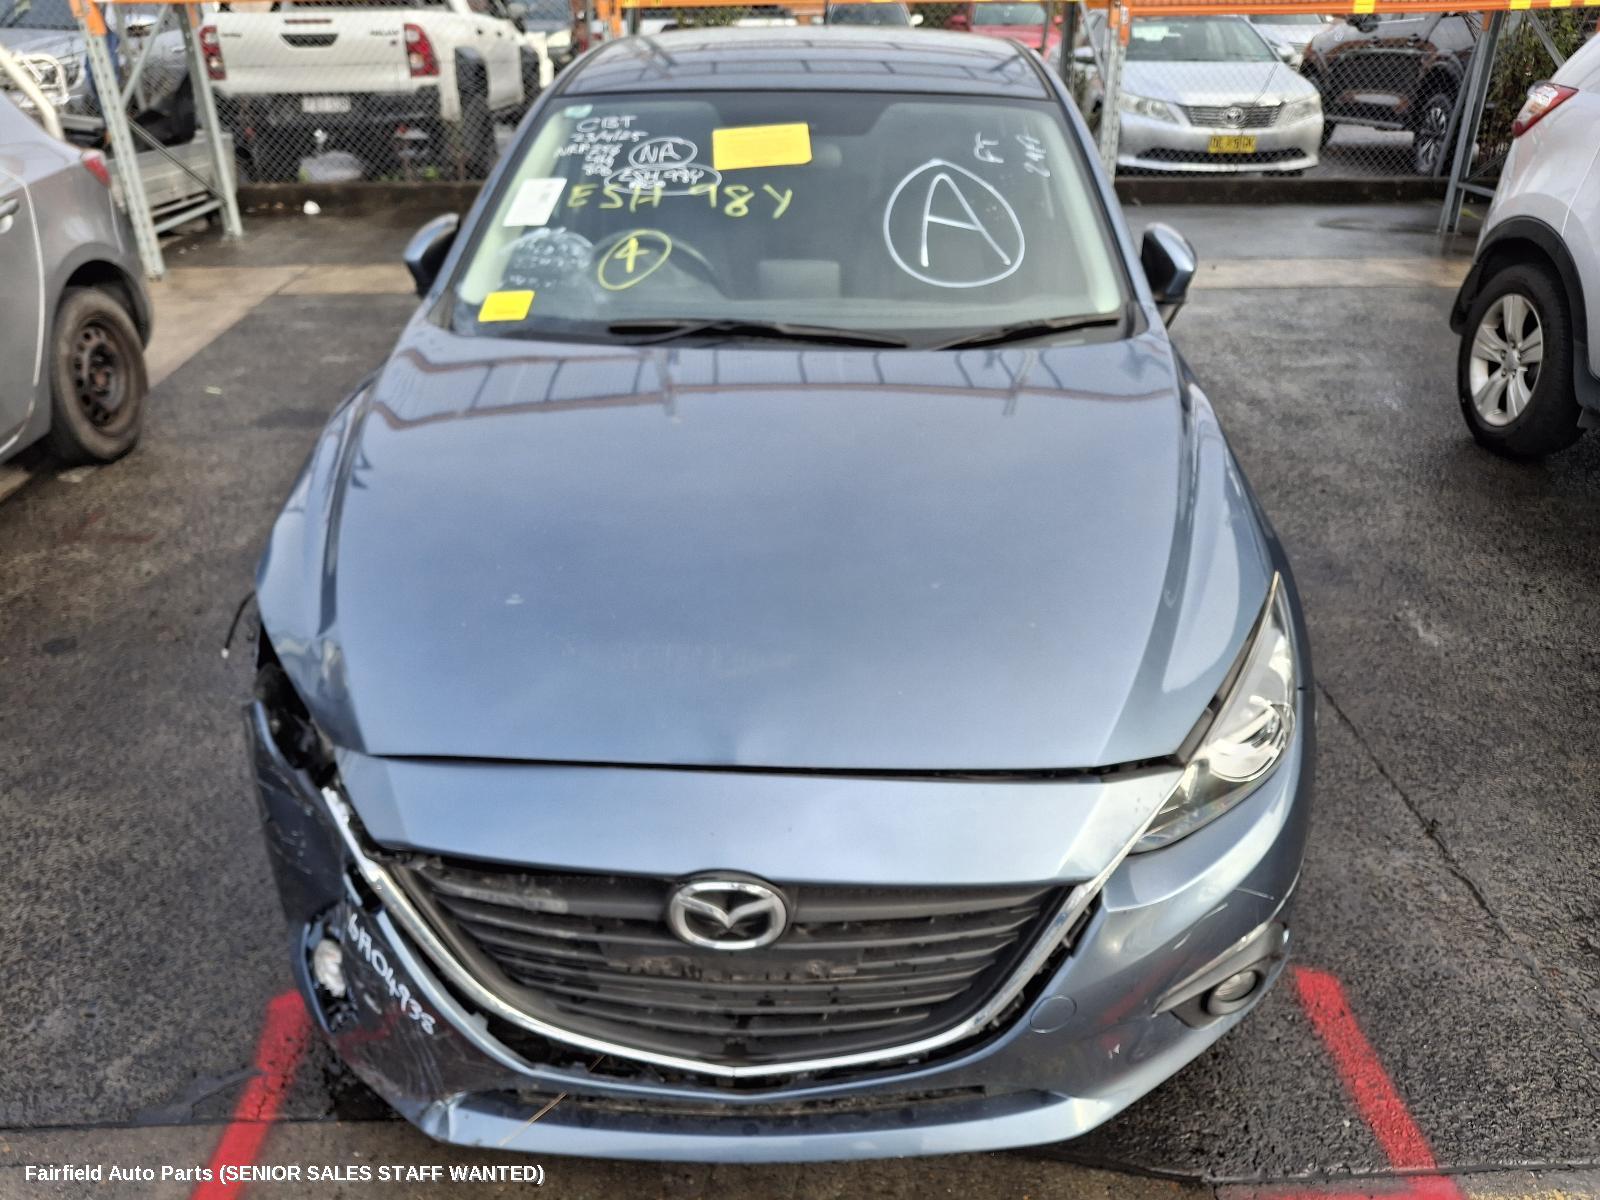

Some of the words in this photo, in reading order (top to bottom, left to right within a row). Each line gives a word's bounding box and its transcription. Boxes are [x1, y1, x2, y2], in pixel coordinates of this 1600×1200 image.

[638, 141, 683, 164] NA
[567, 183, 663, 213] ESH
[688, 183, 793, 219] 98Y
[920, 172, 1011, 268] A
[614, 236, 649, 274] 4
